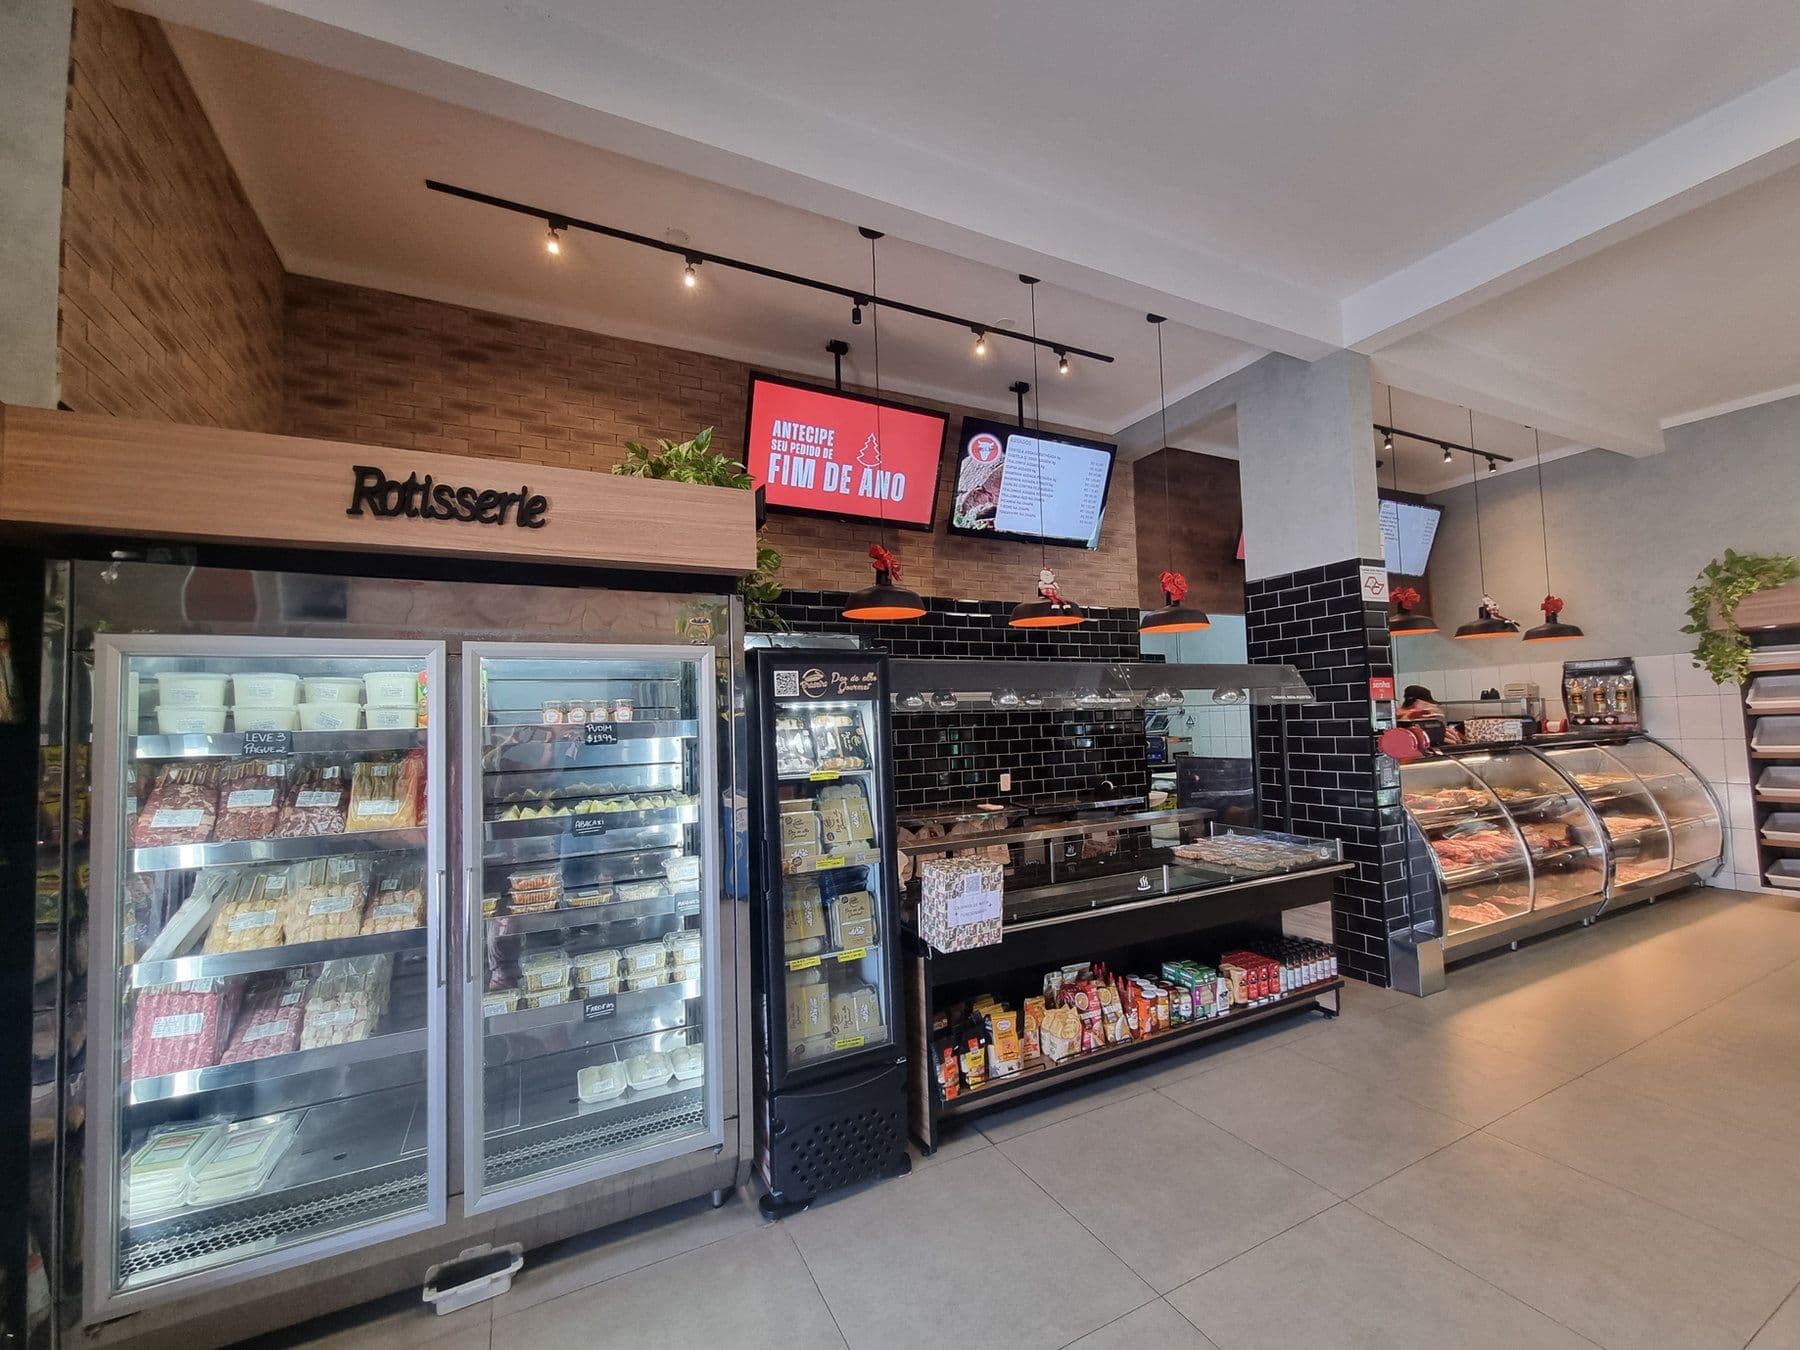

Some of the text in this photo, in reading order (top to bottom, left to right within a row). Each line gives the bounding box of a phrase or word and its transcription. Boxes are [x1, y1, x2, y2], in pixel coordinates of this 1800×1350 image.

[772, 419, 835, 447] ANTECIPE
[771, 439, 834, 460] SEU PEDIDO DE
[767, 452, 906, 502] FIM DE ANO
[346, 465, 548, 529] Rotisserie
[243, 742, 275, 754] PAGUE
[245, 732, 286, 743] LEVE 3
